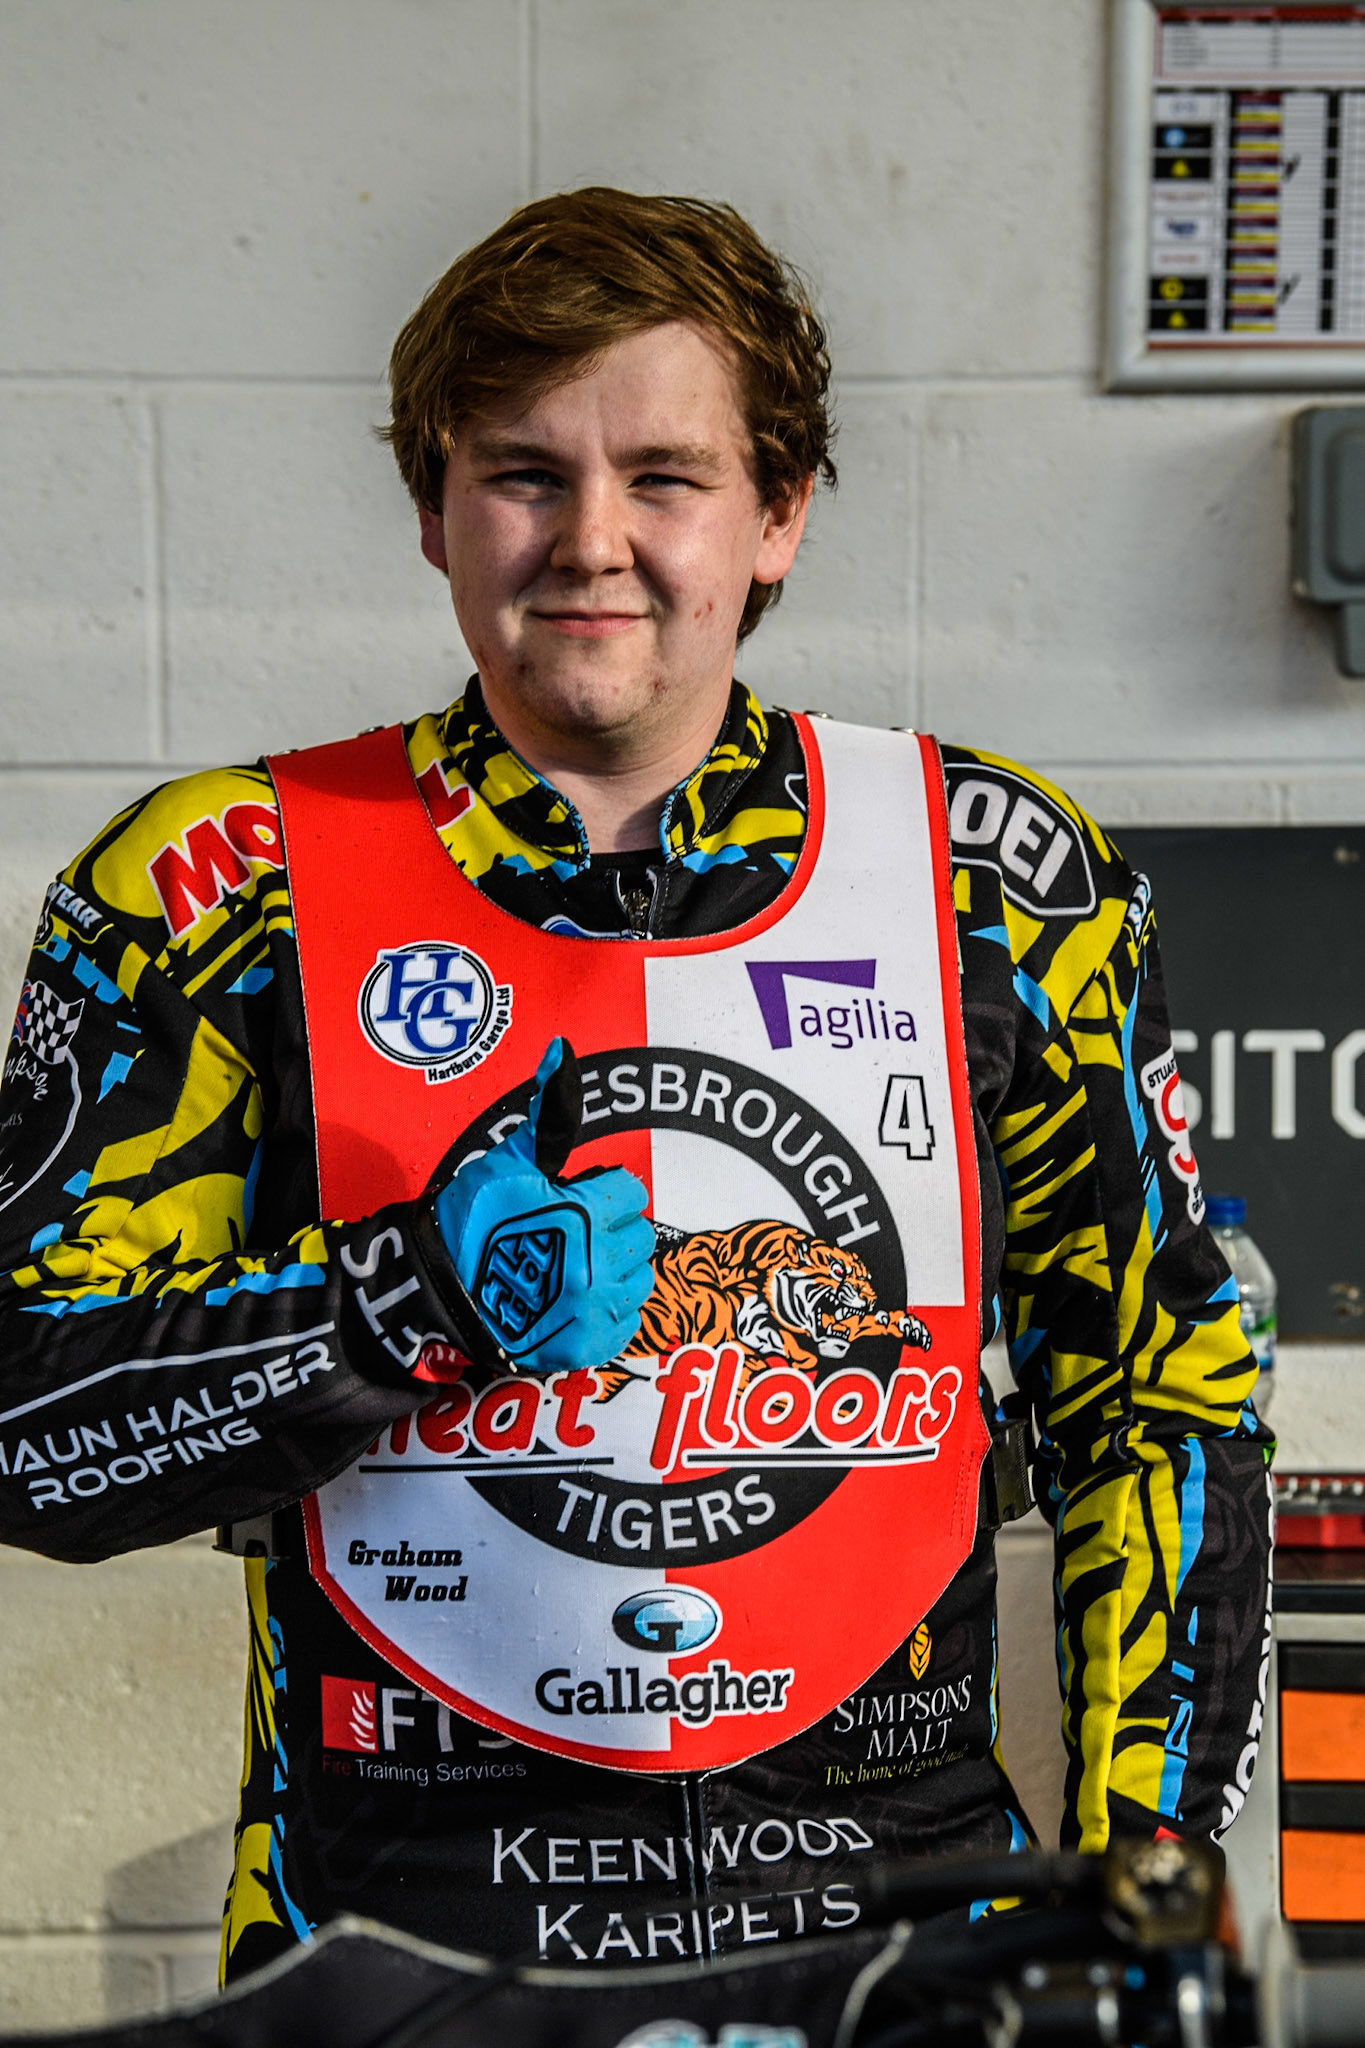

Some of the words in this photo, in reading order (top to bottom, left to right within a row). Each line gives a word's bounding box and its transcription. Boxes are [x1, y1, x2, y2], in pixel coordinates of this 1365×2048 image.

[947, 779, 1073, 898] OEI
[427, 1053, 483, 1082] Hartburn
[479, 1009, 509, 1052] Garage
[496, 987, 510, 1007] Ltd
[800, 998, 917, 1049] agilia
[878, 1074, 936, 1161] 4
[0, 1420, 118, 1475] AUN
[126, 1341, 336, 1443] HALDER
[650, 1348, 960, 1470] floors
[27, 1417, 262, 1510] ROOFING
[555, 1474, 777, 1551] TIGERS
[348, 1540, 463, 1567] Graham
[385, 1576, 469, 1602] Wood
[535, 1665, 790, 1723] Gallagher
[834, 1674, 972, 1733] SIMPSONS
[866, 1718, 953, 1760] MALT
[322, 1755, 350, 1776] Fire
[355, 1758, 429, 1787] Training
[436, 1760, 527, 1782] Services
[824, 1763, 854, 1786] The
[857, 1762, 896, 1783] home
